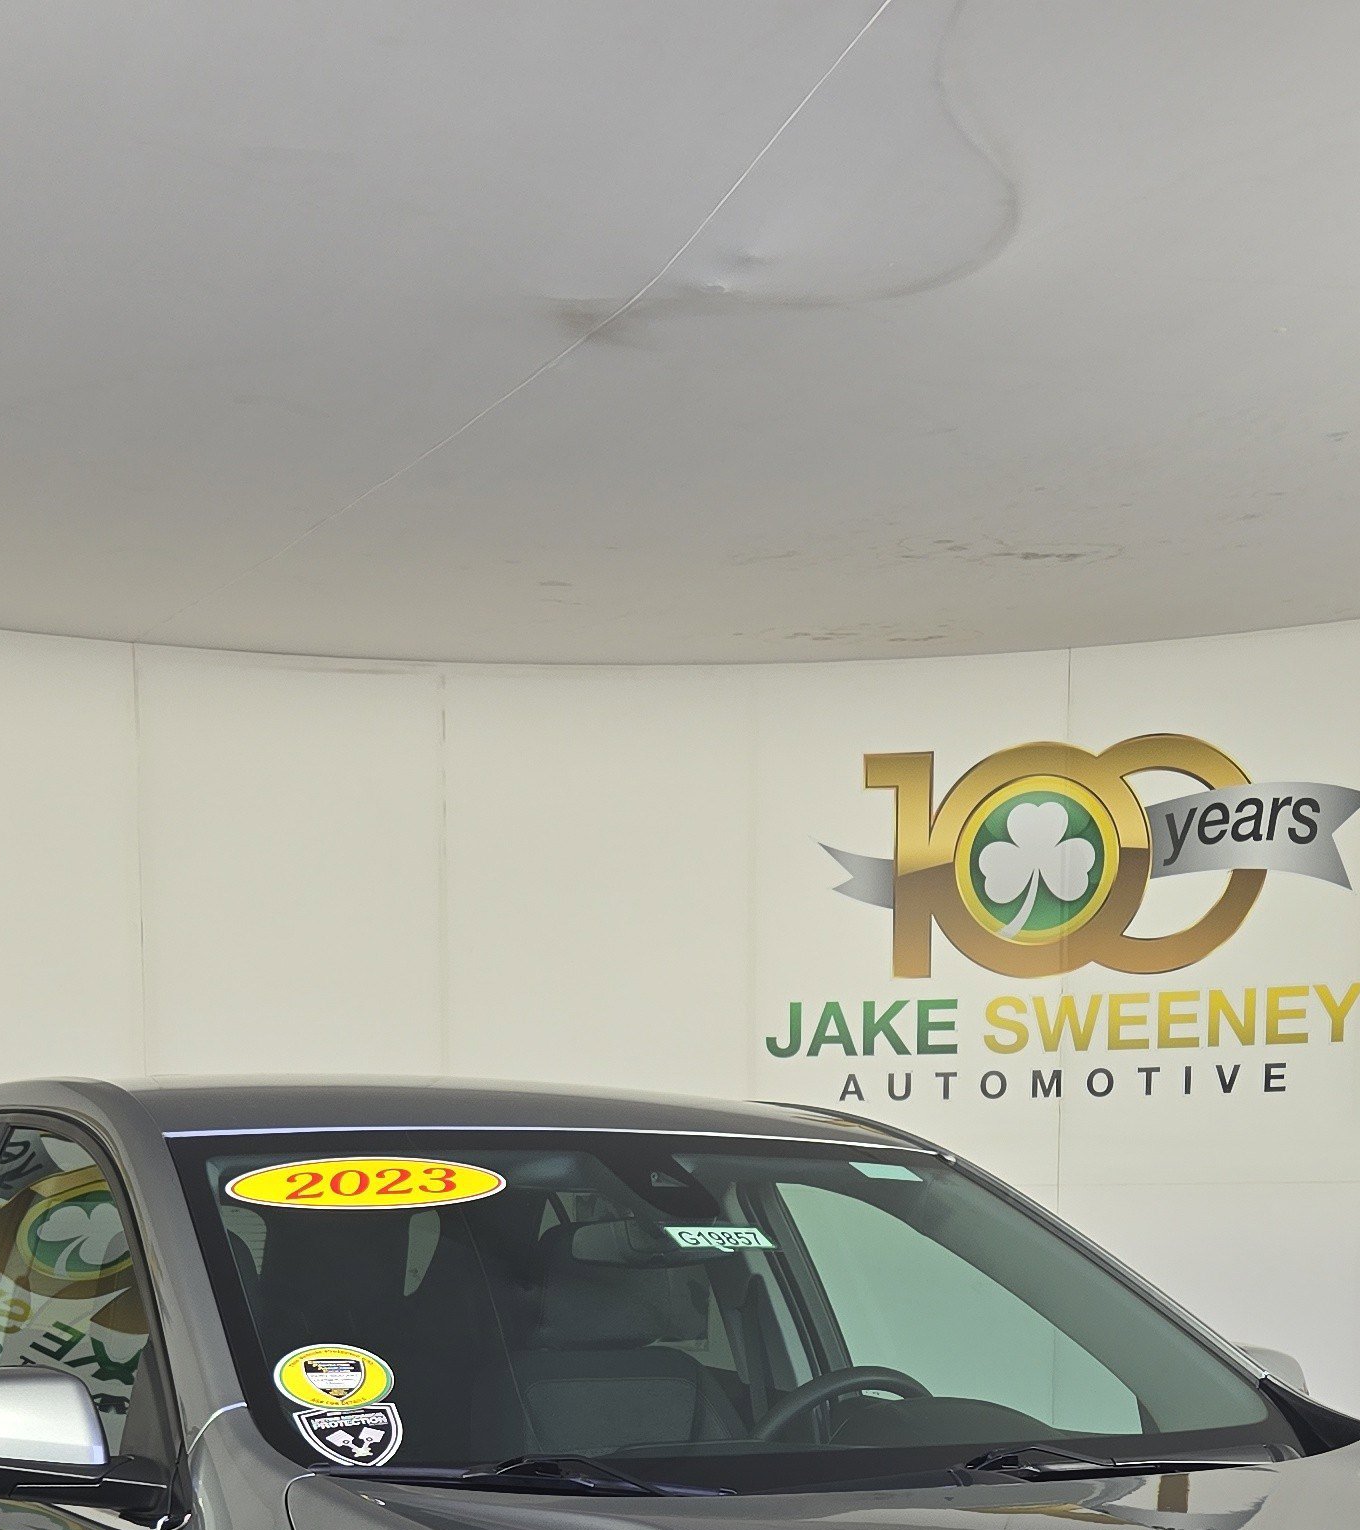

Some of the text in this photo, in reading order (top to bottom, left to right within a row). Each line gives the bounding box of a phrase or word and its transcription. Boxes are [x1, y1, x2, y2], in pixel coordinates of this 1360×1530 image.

[1162, 796, 1321, 867] years
[765, 998, 958, 1060] JAKE
[839, 1062, 1287, 1102] AUTOMOTIVE
[286, 1167, 457, 1200] 2023
[678, 1231, 762, 1246] G19857
